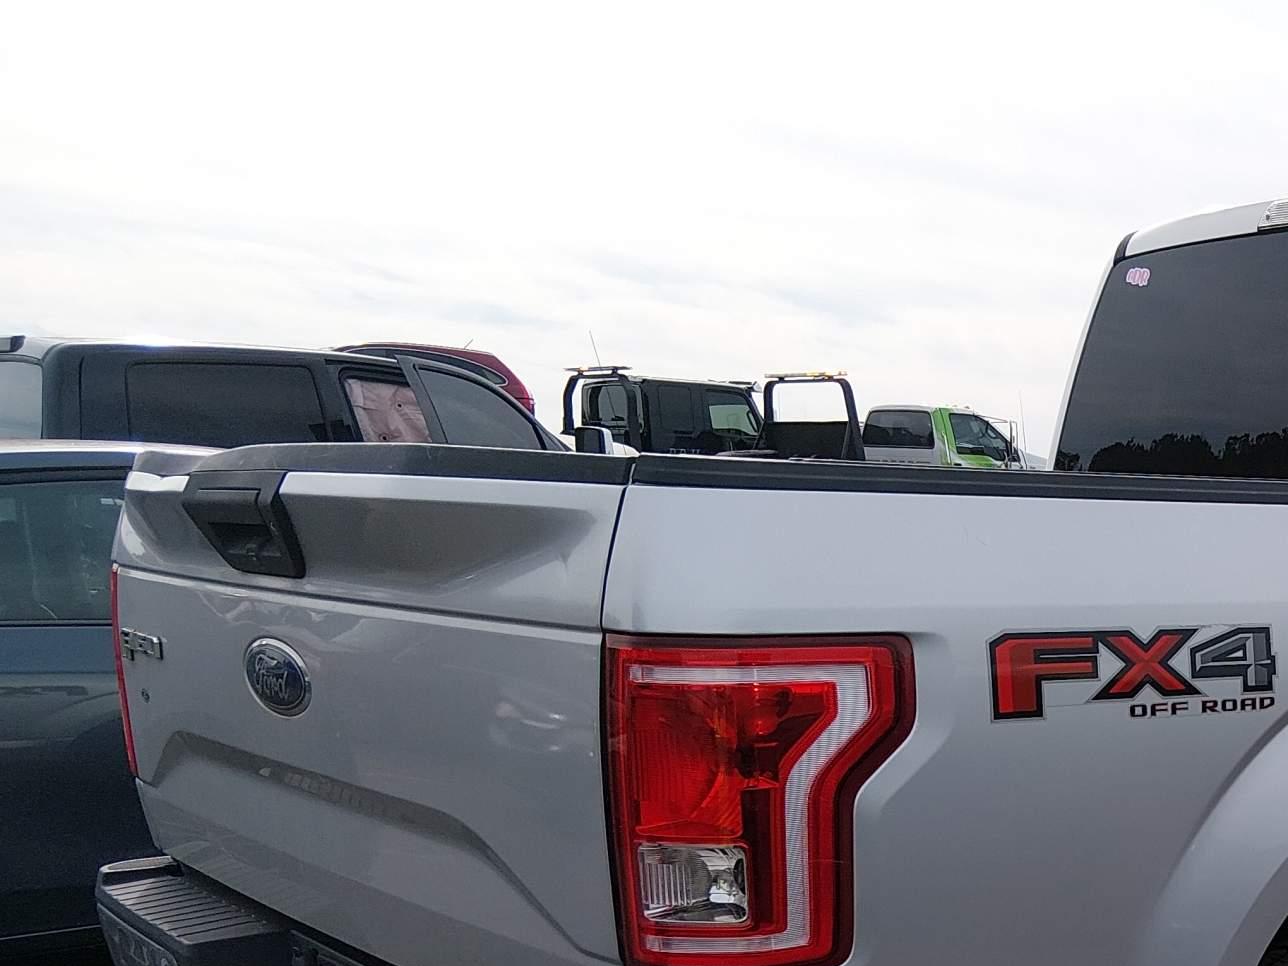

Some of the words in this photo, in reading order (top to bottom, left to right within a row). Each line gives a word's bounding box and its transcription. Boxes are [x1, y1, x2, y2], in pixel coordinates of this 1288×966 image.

[989, 627, 1276, 719] FX4
[1130, 701, 1189, 718] OFF
[1201, 696, 1275, 714] ROAD
